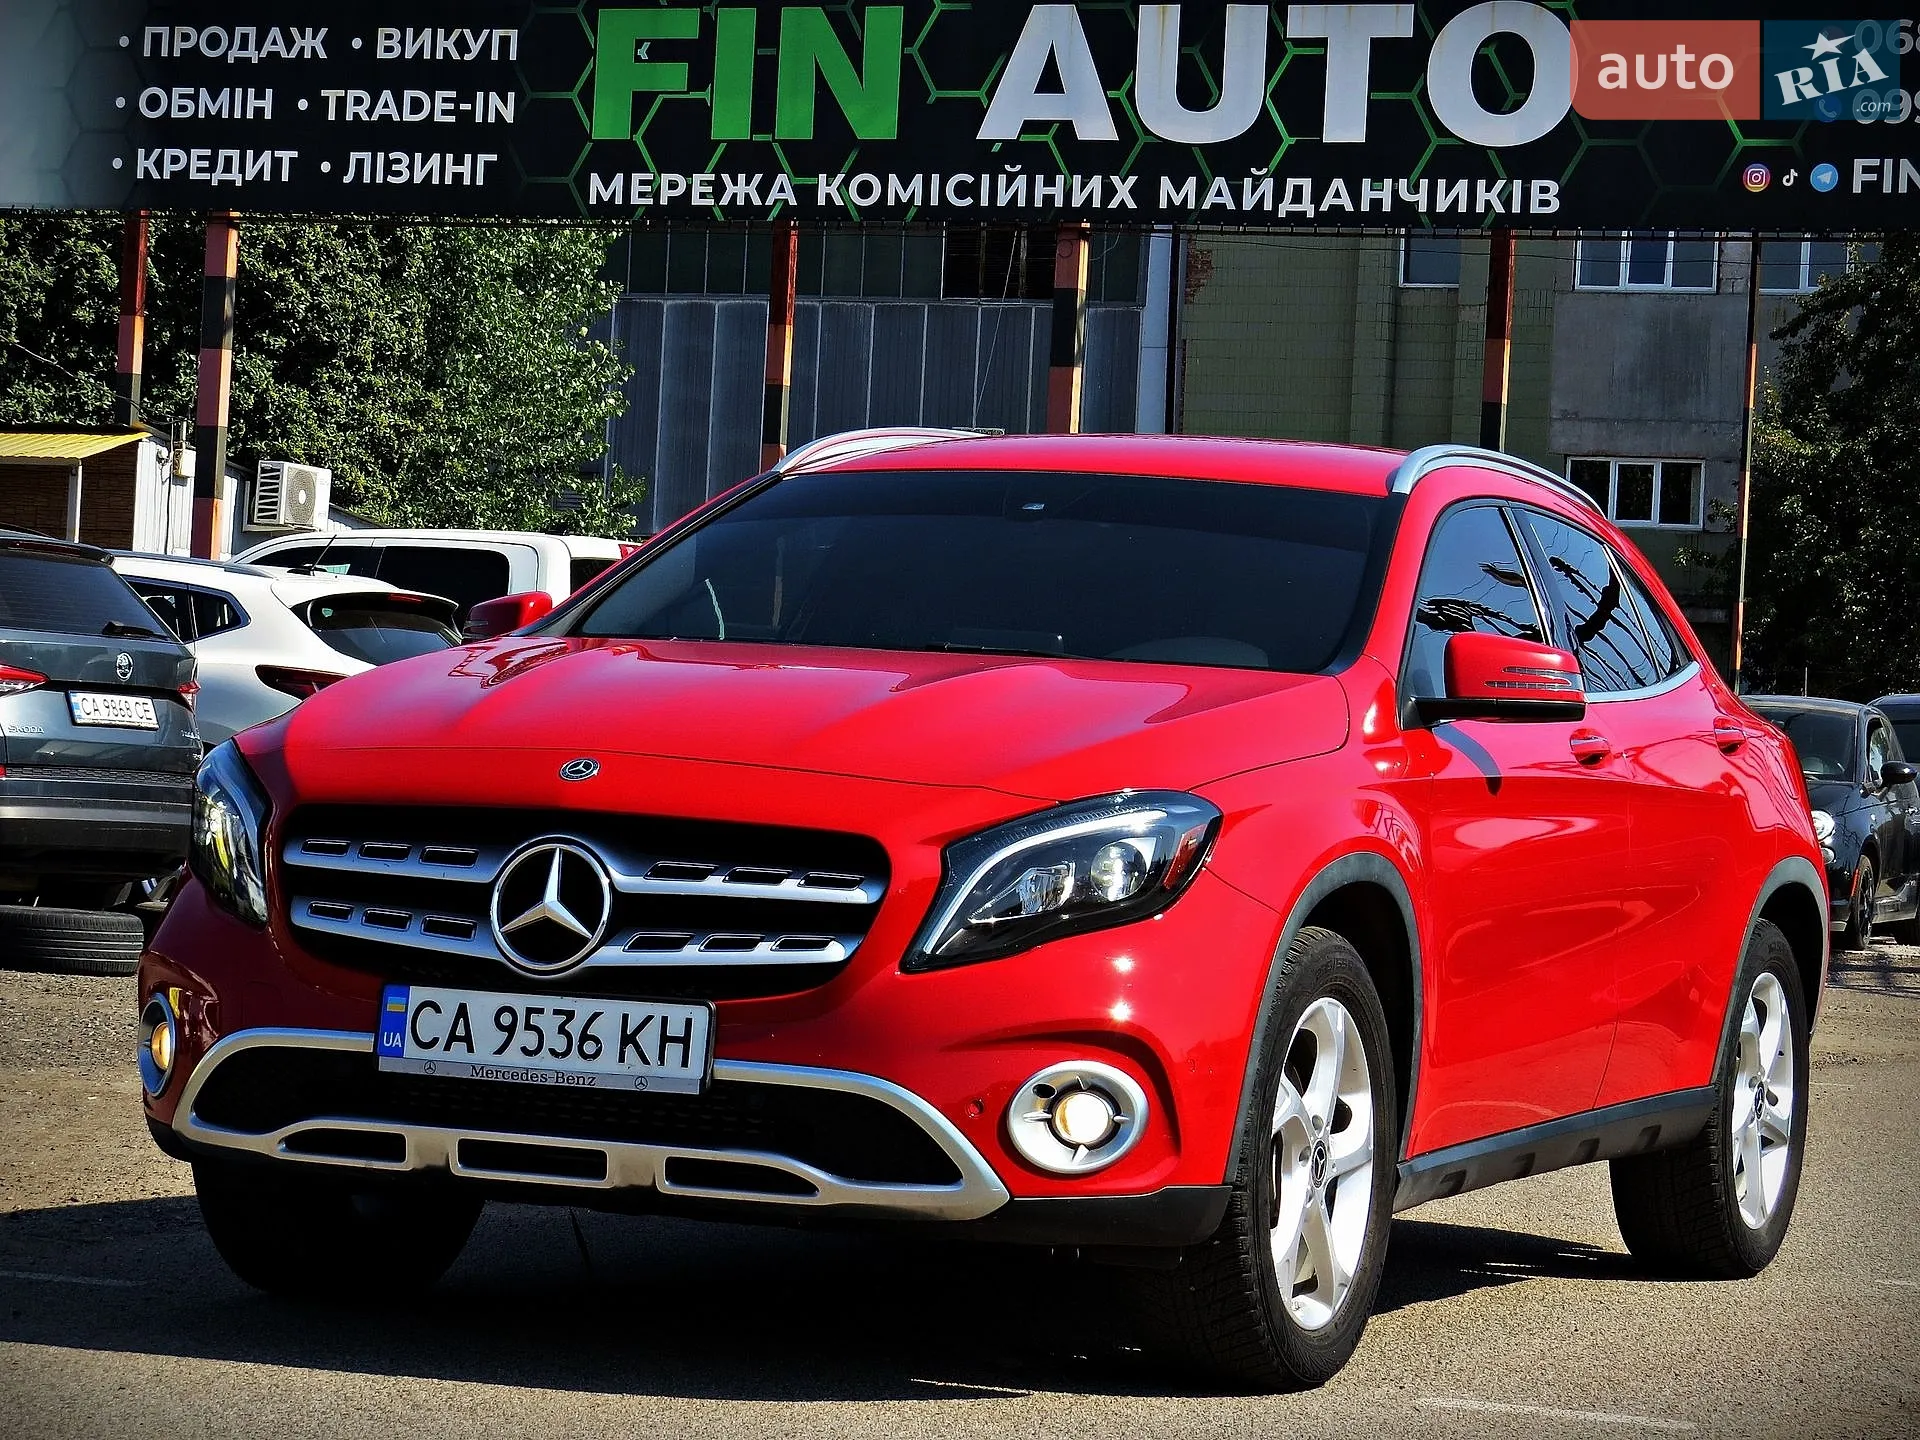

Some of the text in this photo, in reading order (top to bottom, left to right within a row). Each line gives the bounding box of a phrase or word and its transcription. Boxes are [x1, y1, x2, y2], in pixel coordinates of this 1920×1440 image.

[143, 26, 519, 63] ПРОДАЖ ВИКУП
[1853, 19, 1920, 55] 06
[592, 0, 1579, 147] FIN AUTO
[138, 87, 515, 123] ОБМІН TRADE-IN
[1852, 88, 1920, 125] 09
[136, 148, 498, 186] КРЕДИТ ЛІЗИНГ
[588, 164, 1561, 218] МЕРЕЖА КОМІСІЙНИХ МАЙДАНЧИКІВ
[81, 697, 153, 721] CA 9868 CE
[383, 1031, 403, 1048] UA
[410, 1000, 693, 1068] CA 9536 KH
[470, 1064, 597, 1087] Mercedes-Benz
